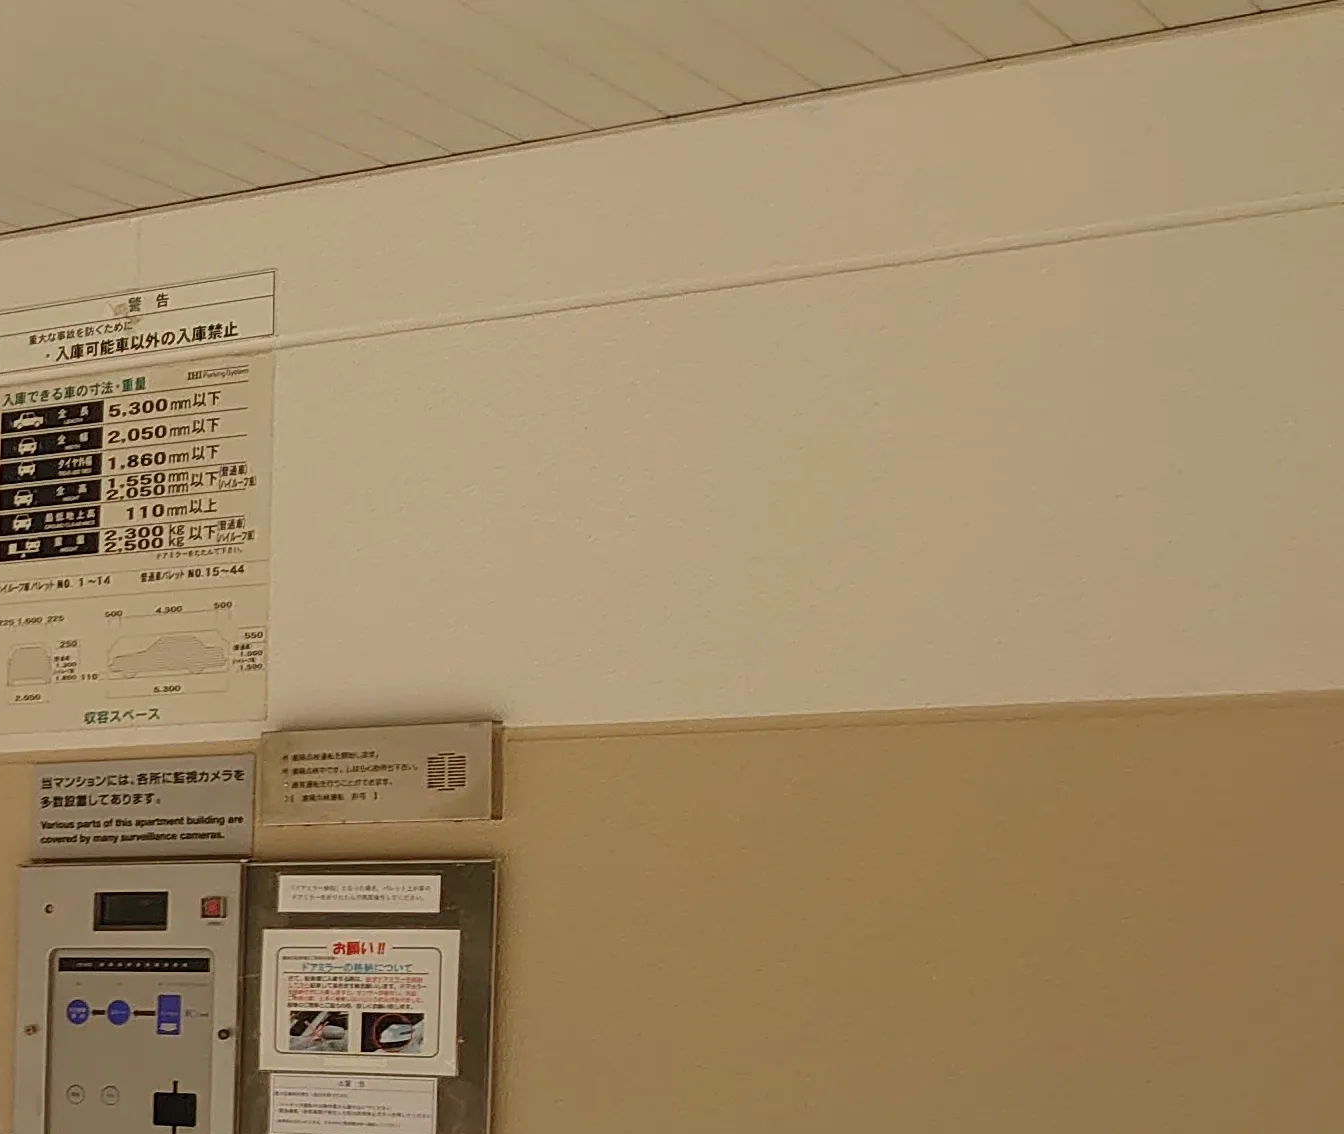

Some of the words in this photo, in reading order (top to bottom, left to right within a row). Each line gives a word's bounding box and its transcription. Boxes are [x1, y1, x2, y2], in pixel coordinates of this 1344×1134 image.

[128, 293, 169, 312] 警告
[29, 321, 132, 345] 重大な事故を防ぐために
[187, 370, 202, 380] IHI
[2, 377, 146, 407] 入庫できる車の寸法・重量
[191, 471, 219, 487] 以下
[189, 525, 217, 540] 以下
[214, 600, 233, 610] 500
[83, 708, 161, 725] 収容スペース
[41, 769, 245, 789] 当マンションには、各所に監視カメラを
[40, 792, 162, 809] 多数設置してあります。
[40, 820, 75, 830] Various
[76, 820, 102, 831] parts
[103, 818, 114, 827] of
[115, 817, 133, 828] this
[135, 817, 185, 829] apartment
[186, 814, 225, 827] building
[227, 815, 244, 824] are
[40, 834, 78, 844] covered
[79, 834, 91, 845] by
[93, 834, 118, 845] many
[120, 831, 177, 843] surveillance
[179, 830, 225, 841] cameras.
